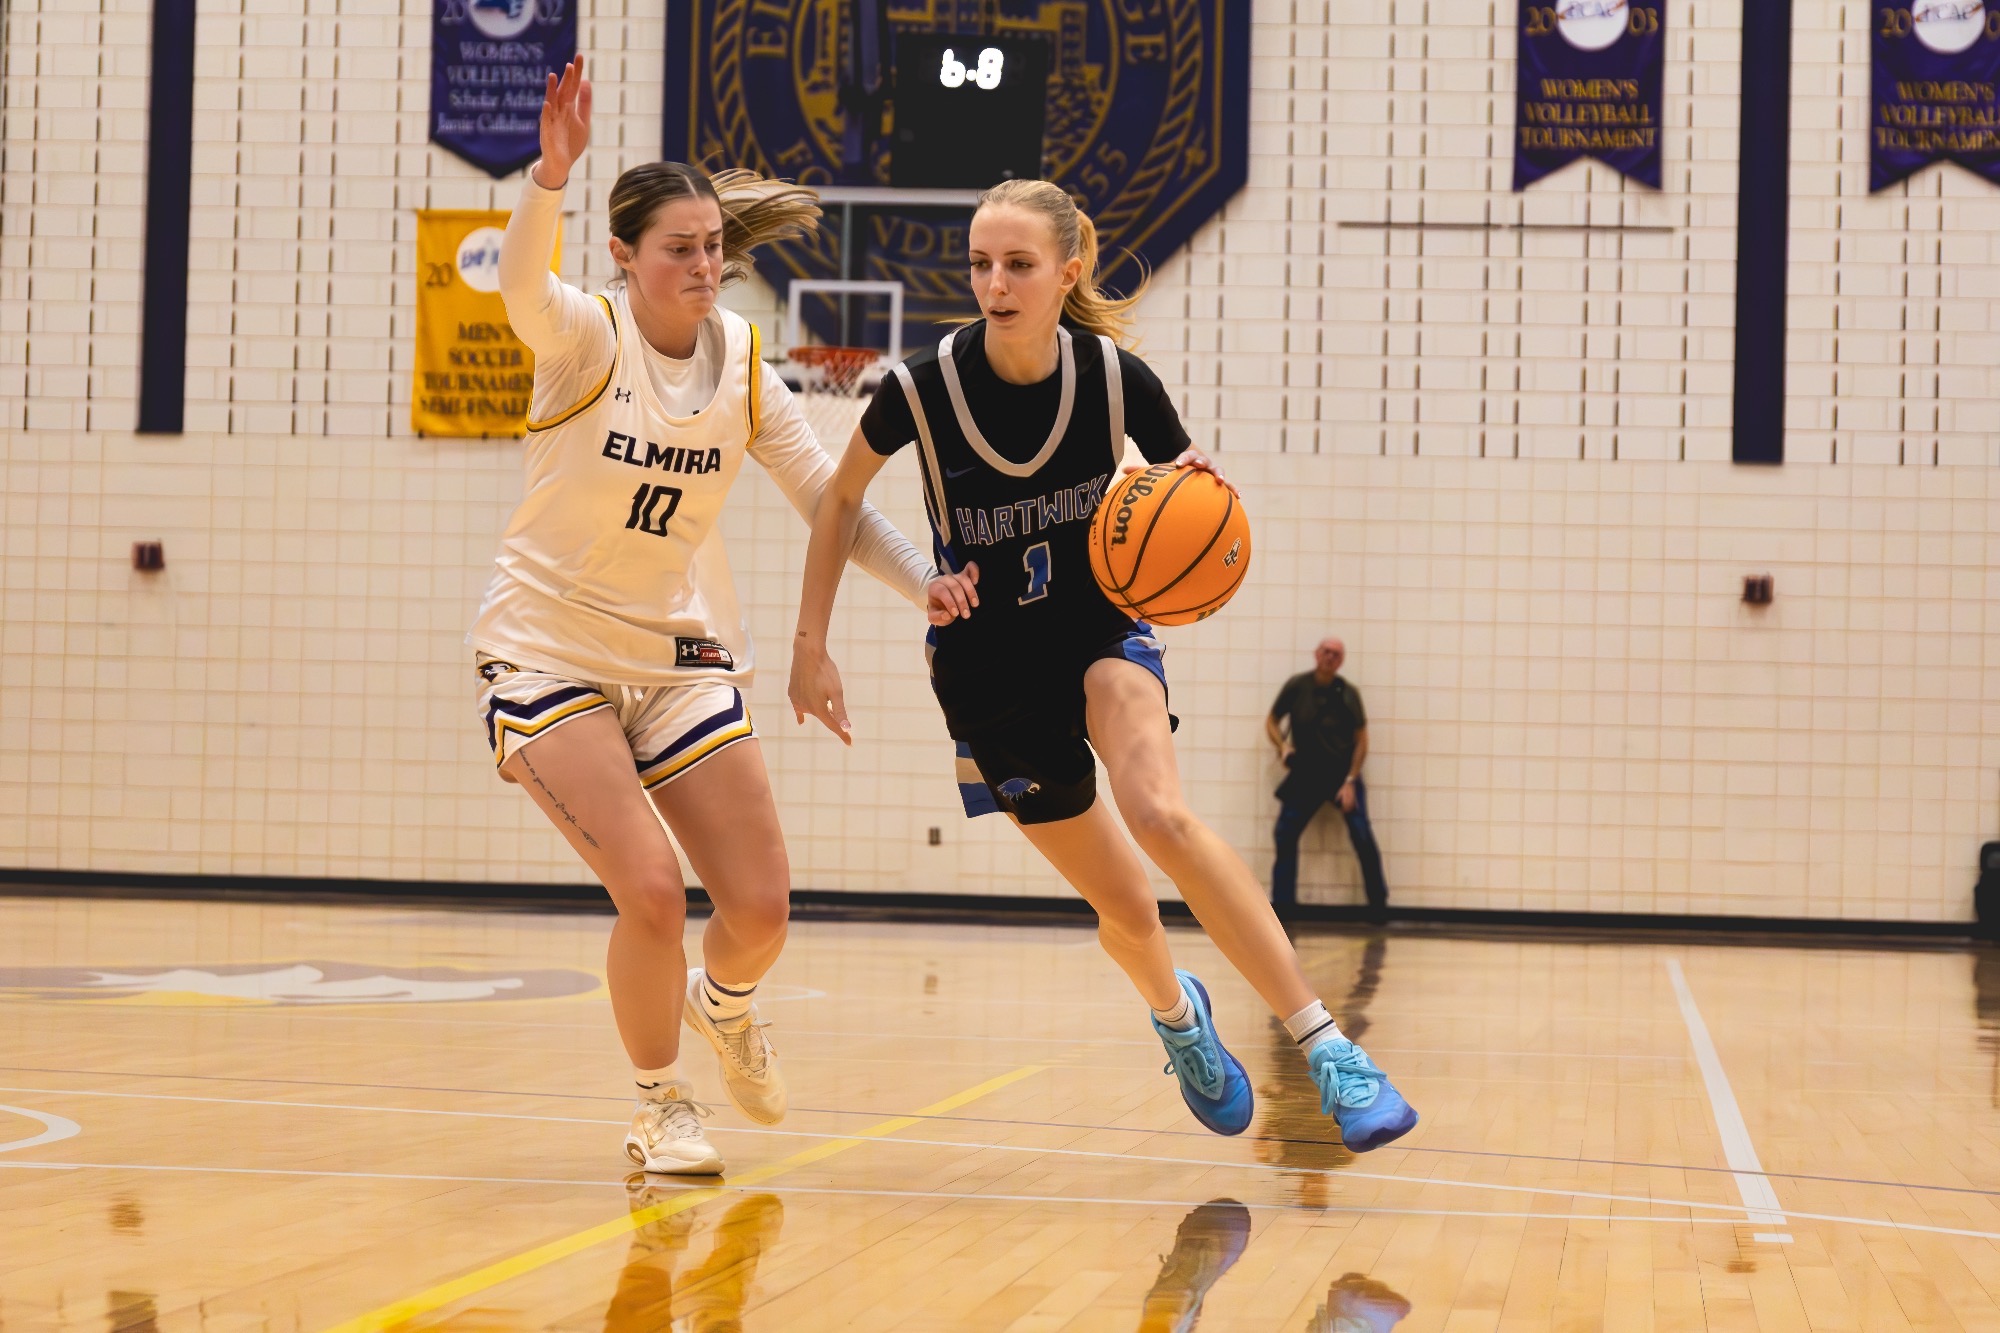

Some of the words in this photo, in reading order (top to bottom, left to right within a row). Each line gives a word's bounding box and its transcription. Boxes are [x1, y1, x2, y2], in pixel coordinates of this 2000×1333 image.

[1524, 6, 1557, 37] 20
[1880, 7, 1912, 38] 20
[459, 41, 545, 62] WOMEN'S
[1540, 78, 1639, 99] WOMEN'S
[1896, 80, 1995, 102] WOMEN'S
[1524, 103, 1654, 125] VOLLEYBALL
[1881, 104, 2000, 127] VOLLEYBAL
[1519, 127, 1658, 150] TOURNAMENT
[1874, 126, 2000, 151] TOURNAMEN
[422, 372, 534, 392] TOURNAMEN
[602, 430, 720, 474] ELMIRA
[625, 483, 682, 537] 10
[956, 473, 1108, 545] HARTWICK
[1112, 464, 1177, 547] Wilson
[1018, 541, 1051, 606] 1
